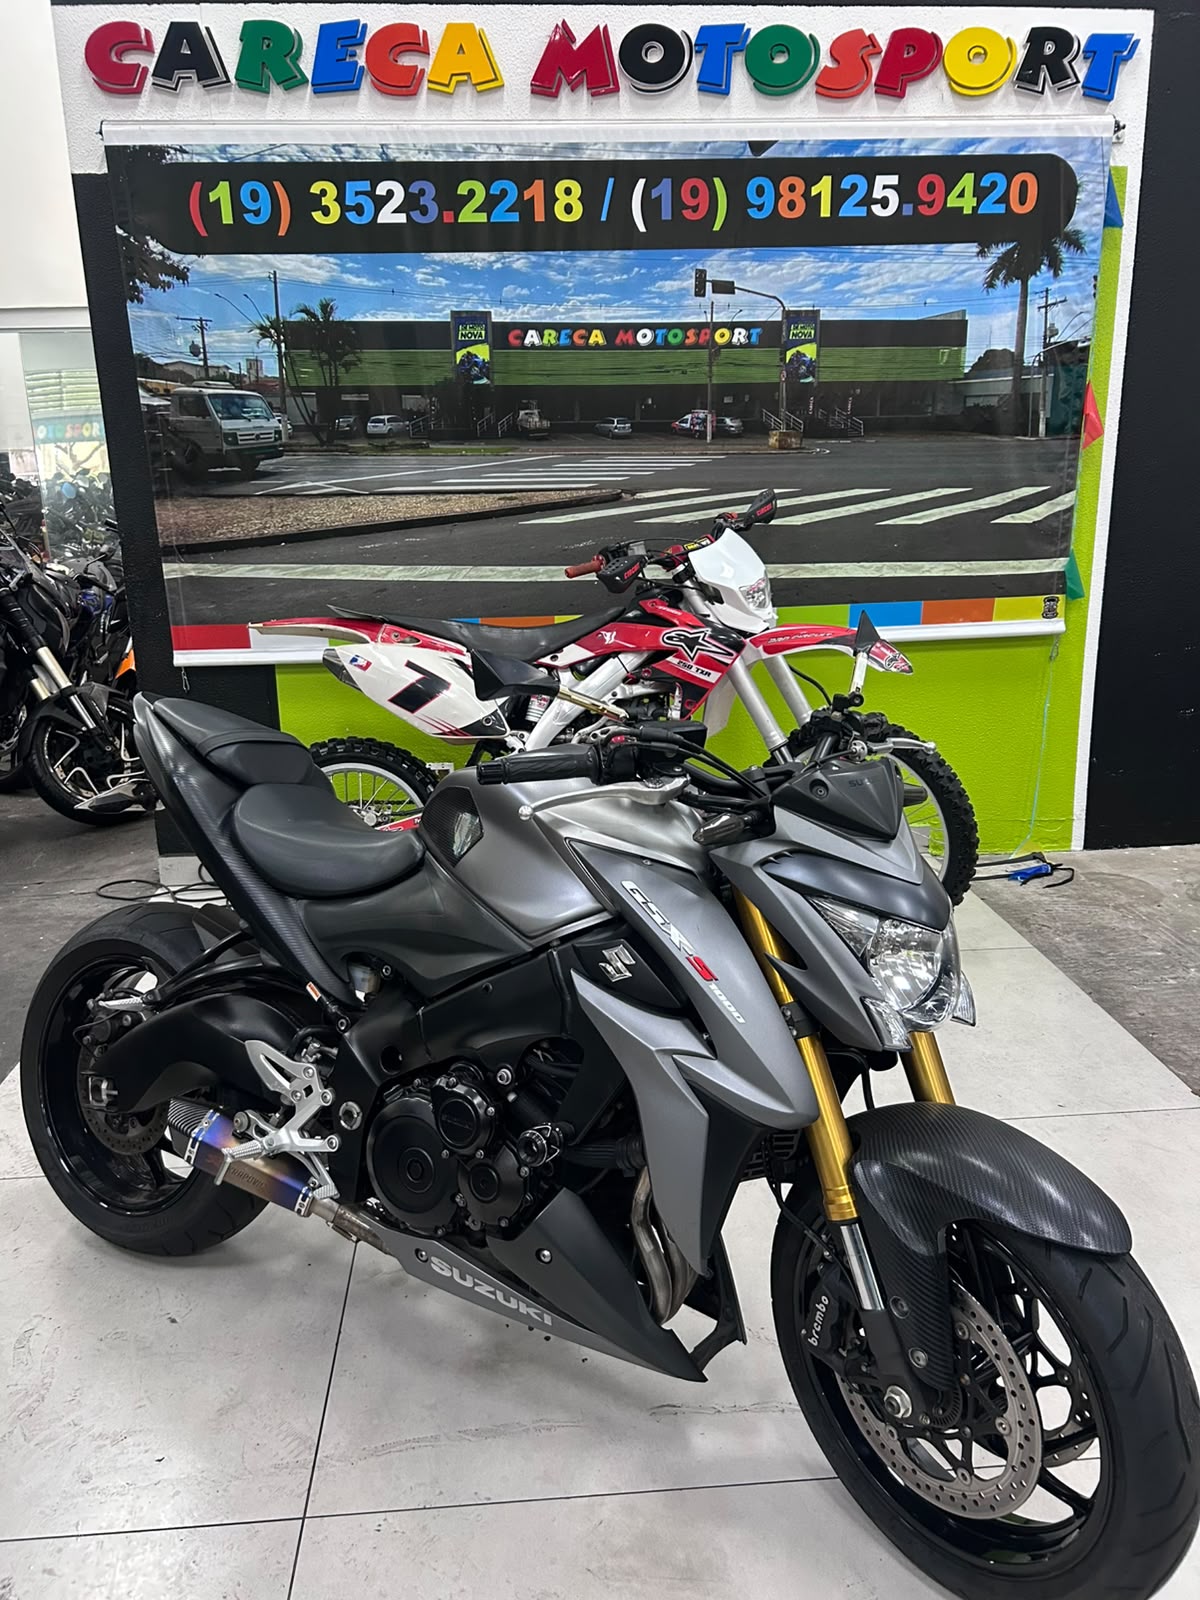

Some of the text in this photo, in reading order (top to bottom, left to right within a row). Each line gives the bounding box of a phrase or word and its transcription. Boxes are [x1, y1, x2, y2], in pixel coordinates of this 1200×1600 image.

[84, 19, 1141, 101] CARECA MOTOSPORT
[188, 180, 292, 237] (19)
[310, 178, 584, 225] 3523.2218
[631, 176, 728, 233] (19)
[746, 172, 1039, 220] 98125.9420
[508, 326, 763, 347] CARECA MOTOSPORT
[707, 982, 746, 1024] 1000
[430, 1256, 553, 1326] SUZUKI
[807, 1295, 829, 1347] brembo
